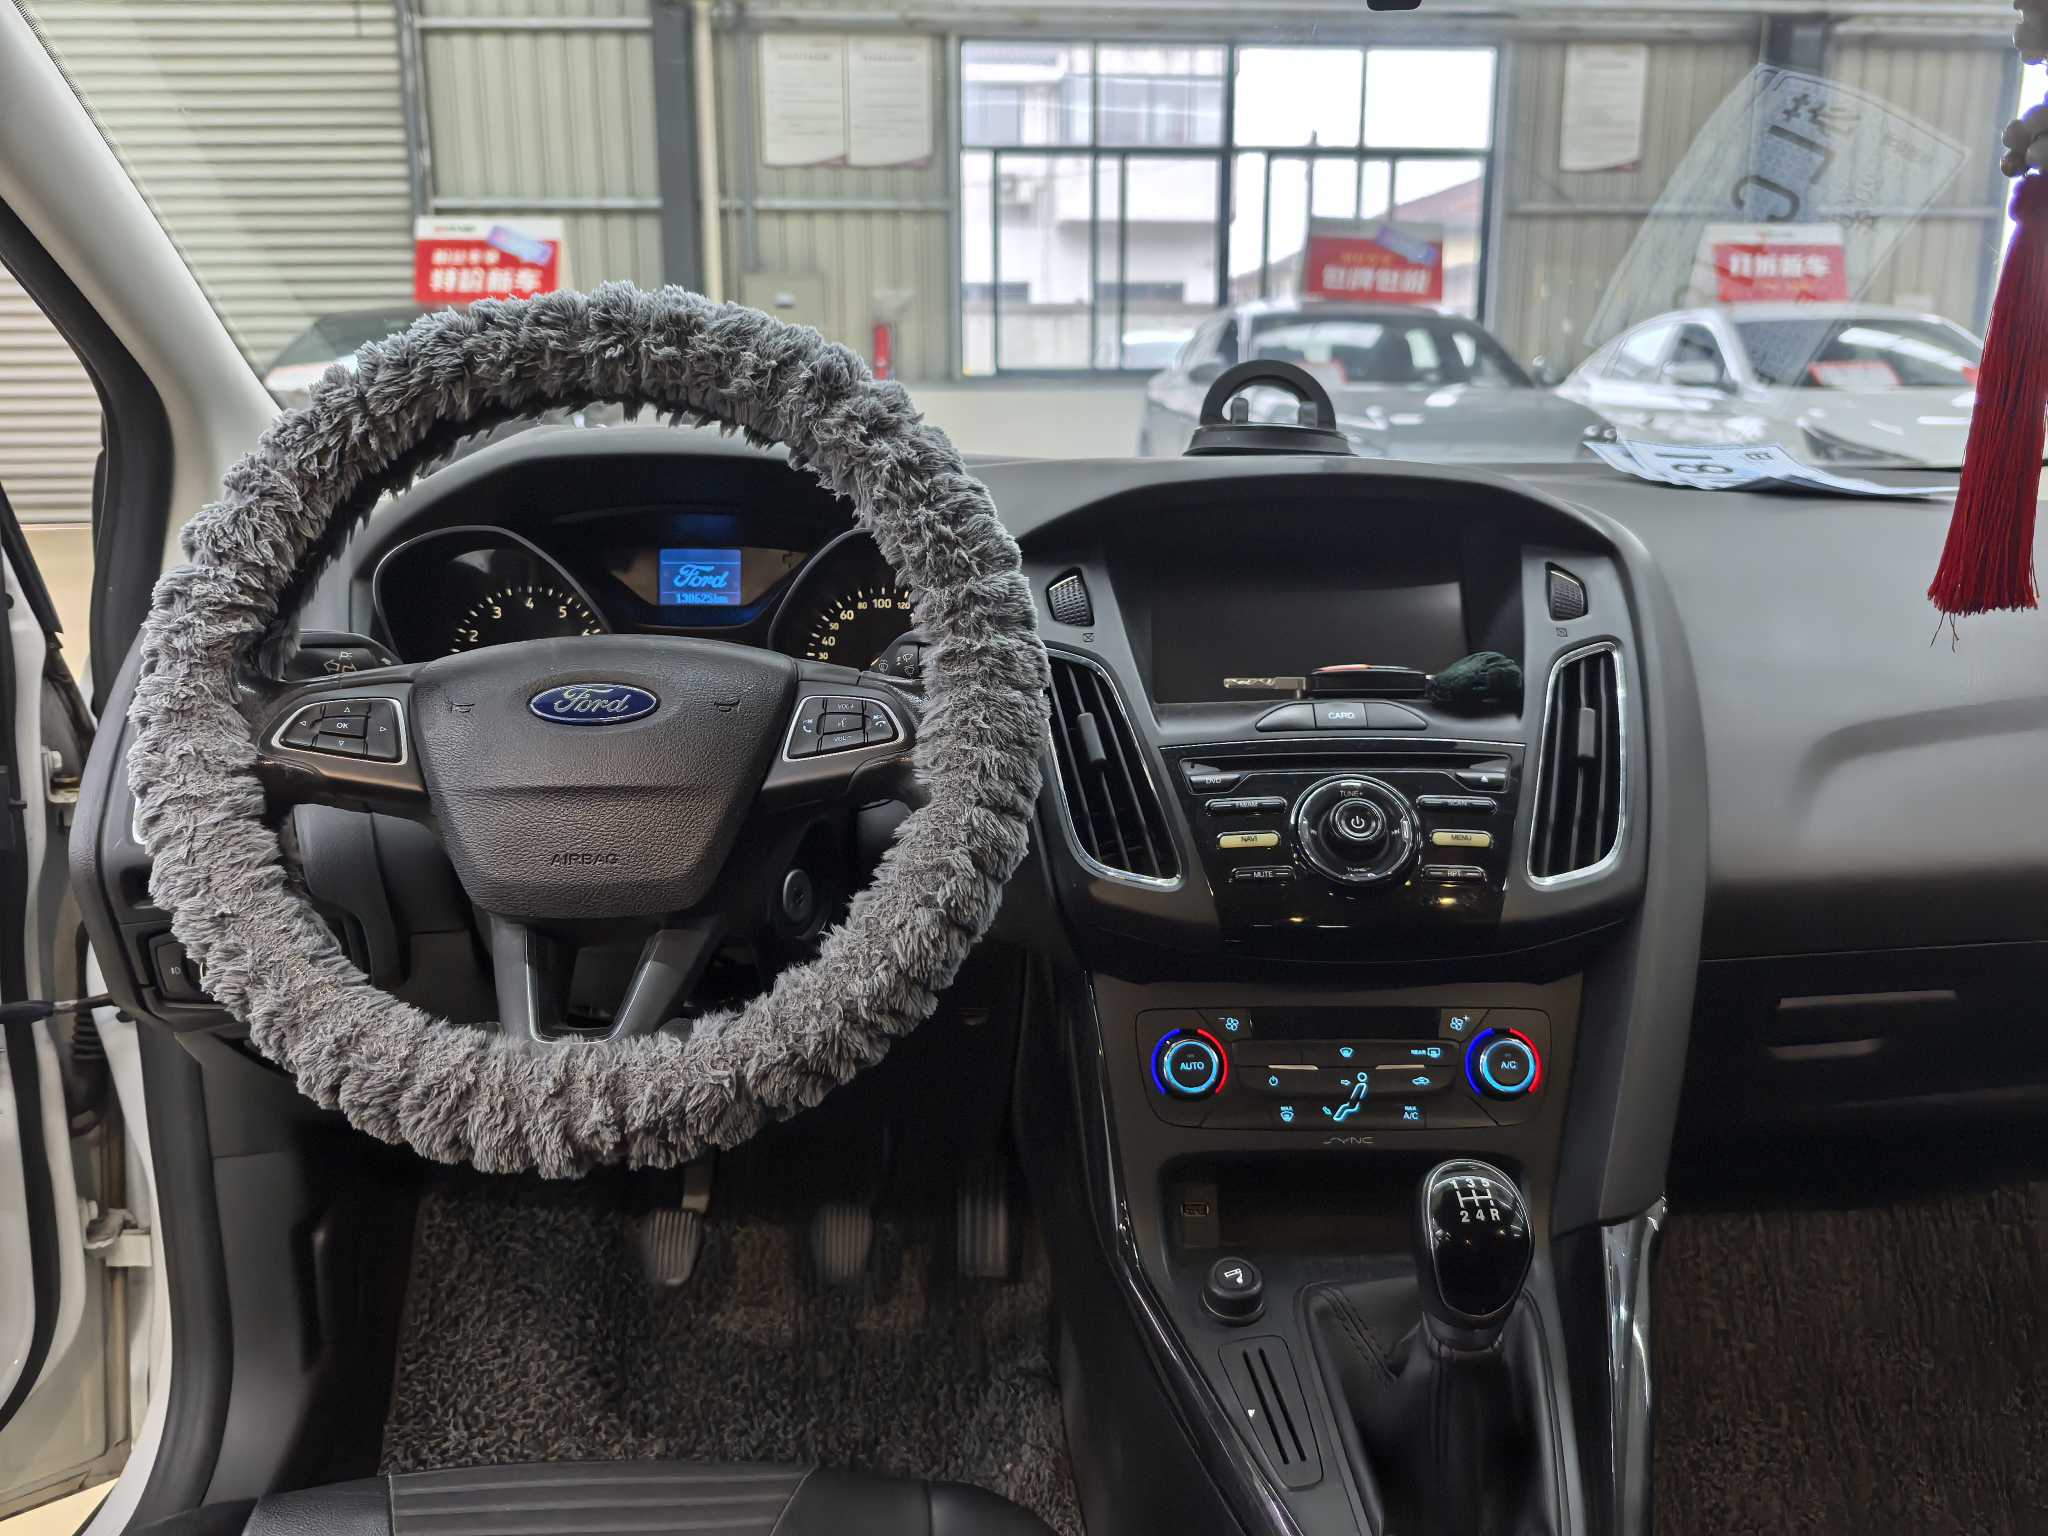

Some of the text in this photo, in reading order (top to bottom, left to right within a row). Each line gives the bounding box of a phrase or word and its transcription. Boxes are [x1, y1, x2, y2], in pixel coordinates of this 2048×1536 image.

[673, 564, 730, 588] Ford
[525, 597, 535, 609] 4
[873, 598, 892, 609] 100
[896, 601, 911, 610] 120
[491, 607, 503, 619] 3
[558, 606, 568, 619] 5
[840, 610, 854, 621] 60
[829, 623, 839, 631] 50
[469, 630, 479, 642] 2
[822, 636, 836, 646] 40
[818, 652, 829, 660] 30
[553, 686, 631, 713] Ford
[1328, 712, 1355, 720] CARD
[551, 853, 619, 866] AIRBAG
[1180, 1061, 1205, 1071] AUTO
[1500, 1061, 1517, 1070] A/C
[1403, 1111, 1419, 1120] A/C
[1322, 1136, 1375, 1145] SYNC
[1450, 1177, 1490, 1190] 1 3 5
[1459, 1208, 1501, 1223] 2 4 R
